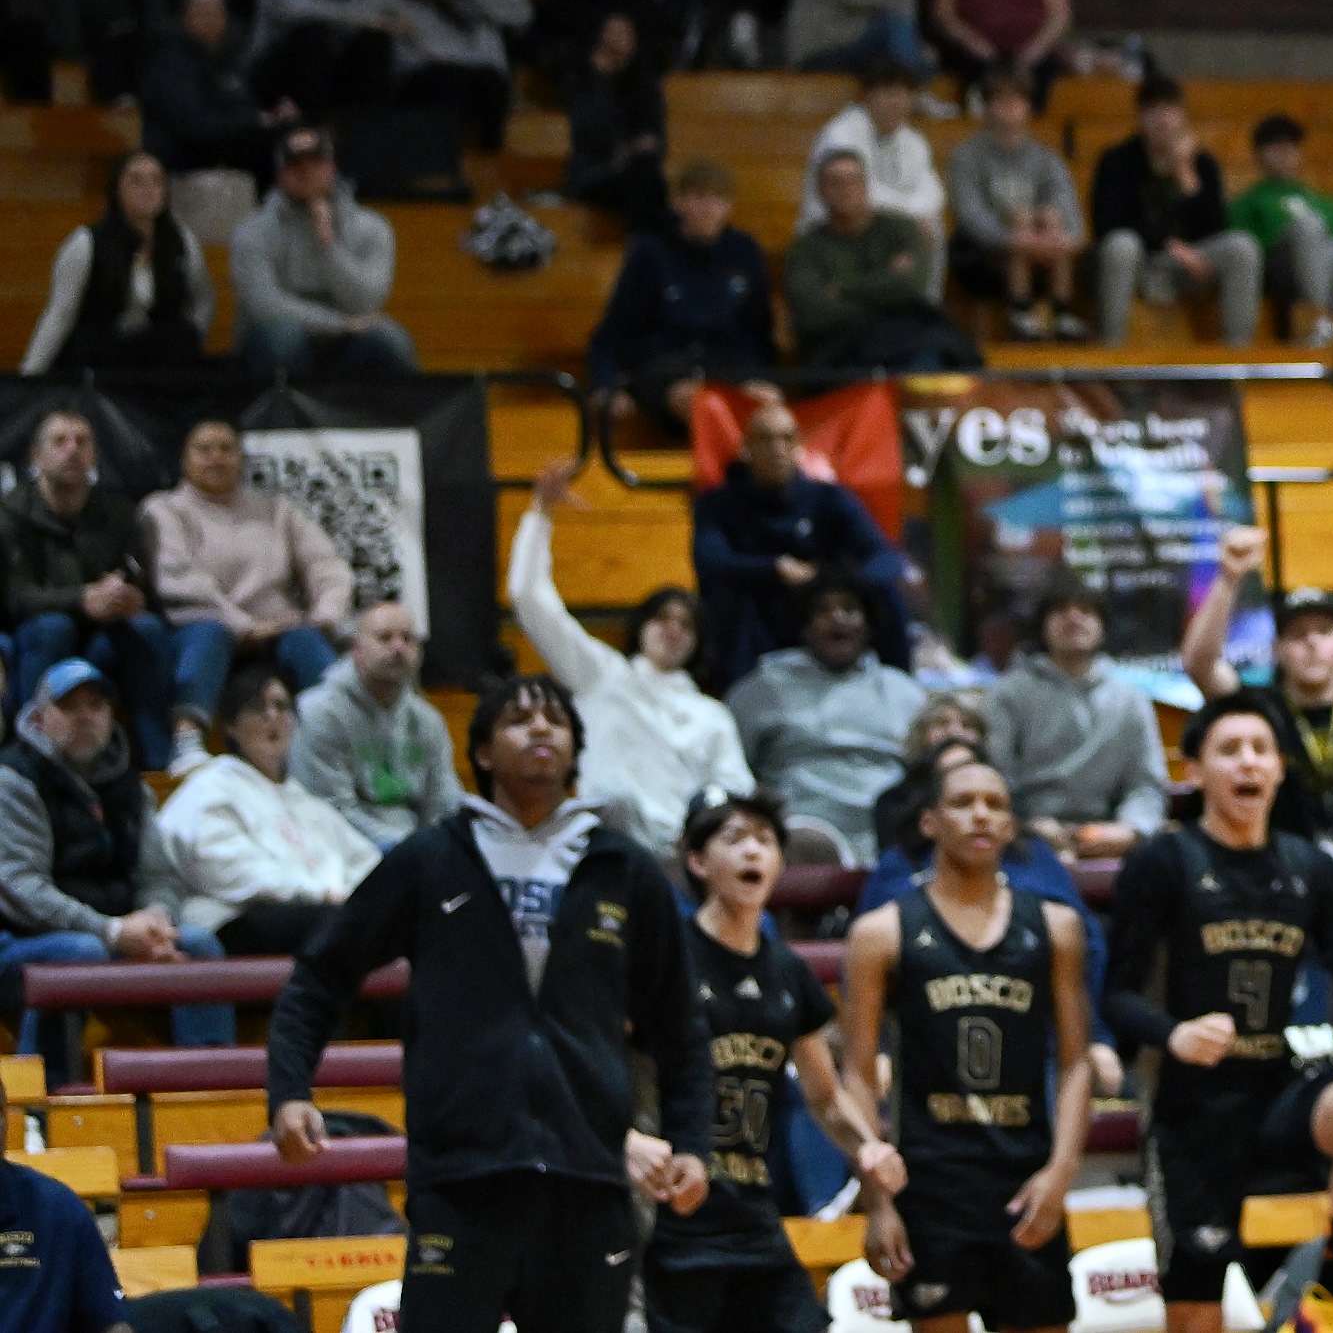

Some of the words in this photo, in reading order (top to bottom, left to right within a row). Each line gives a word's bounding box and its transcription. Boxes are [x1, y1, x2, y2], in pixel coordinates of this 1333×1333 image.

[902, 406, 1052, 486] yes
[925, 973, 1034, 1014] BOSCO
[957, 1016, 1003, 1090] 0
